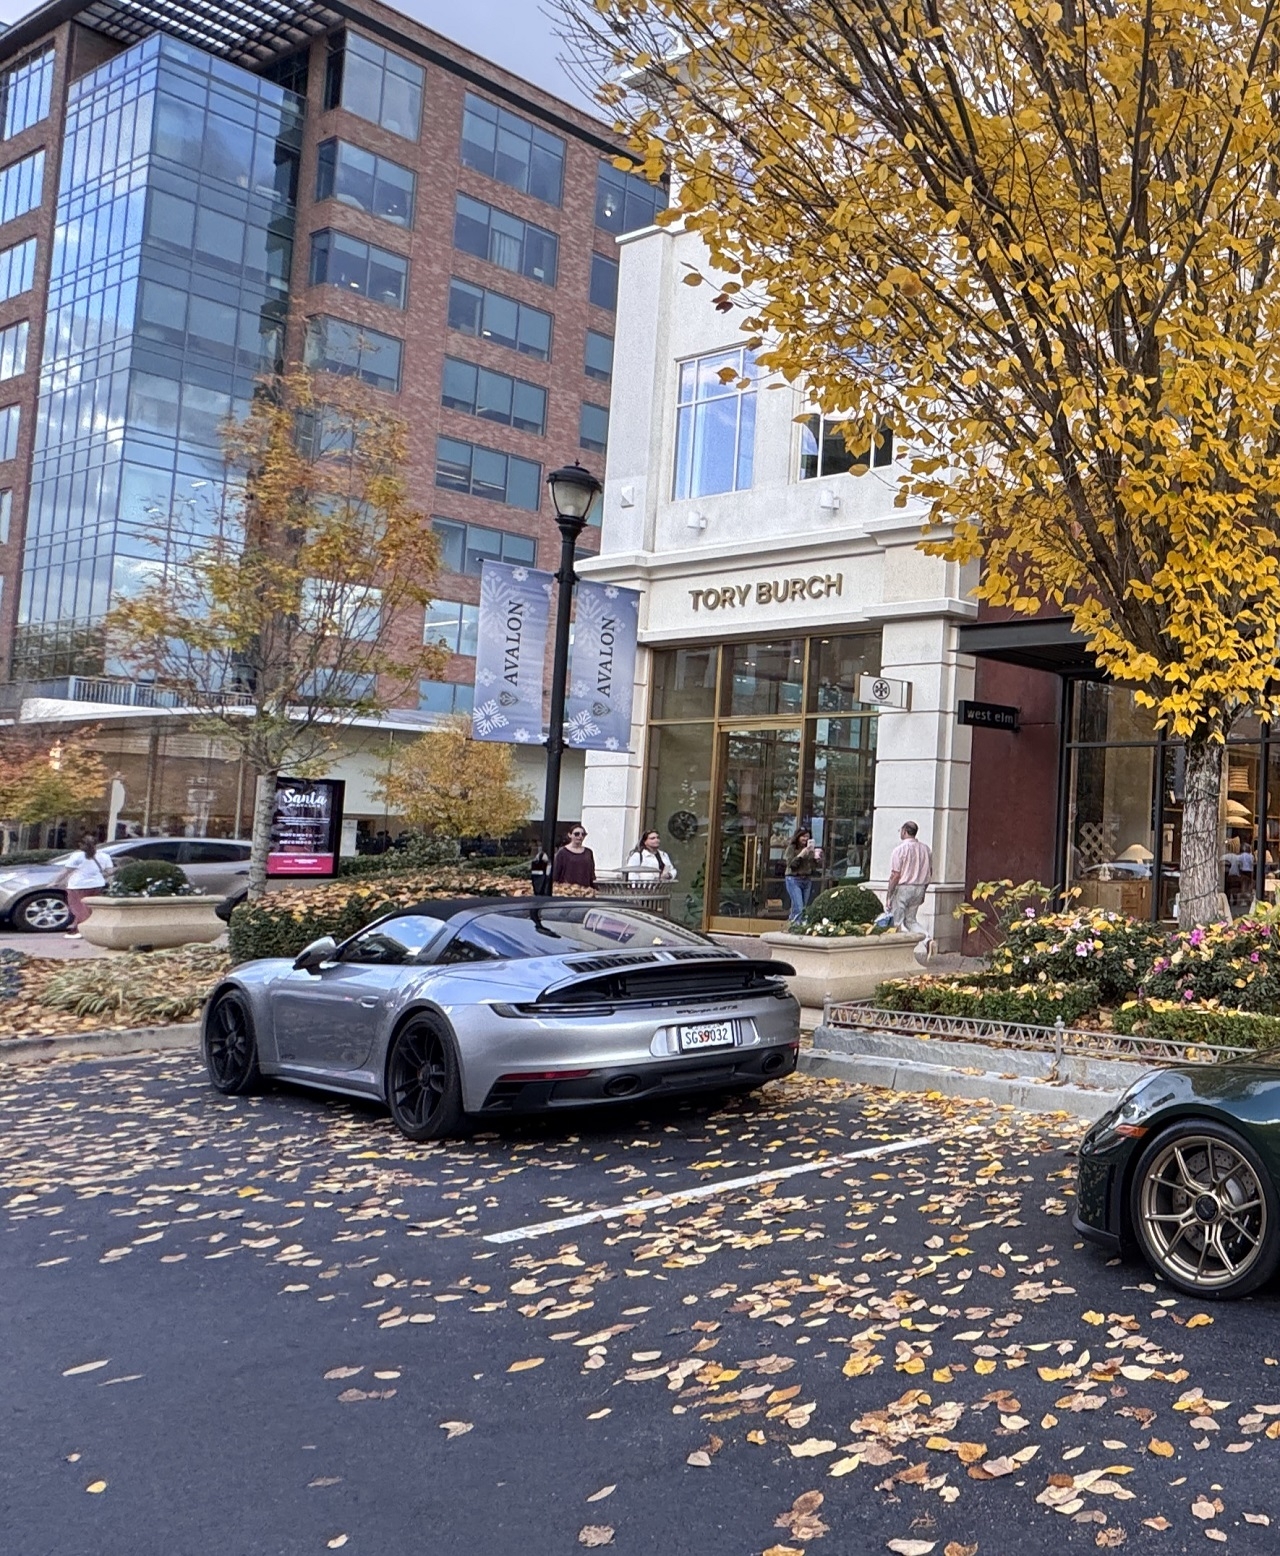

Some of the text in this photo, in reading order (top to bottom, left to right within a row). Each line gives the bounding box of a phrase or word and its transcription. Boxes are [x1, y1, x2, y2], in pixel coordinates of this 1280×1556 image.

[689, 572, 843, 612] TORY BURCH
[503, 600, 524, 687] AVALON
[596, 616, 616, 698] AVALON
[966, 707, 1014, 724] west elm
[283, 789, 327, 805] Santa
[686, 1028, 728, 1044] SGS9032
